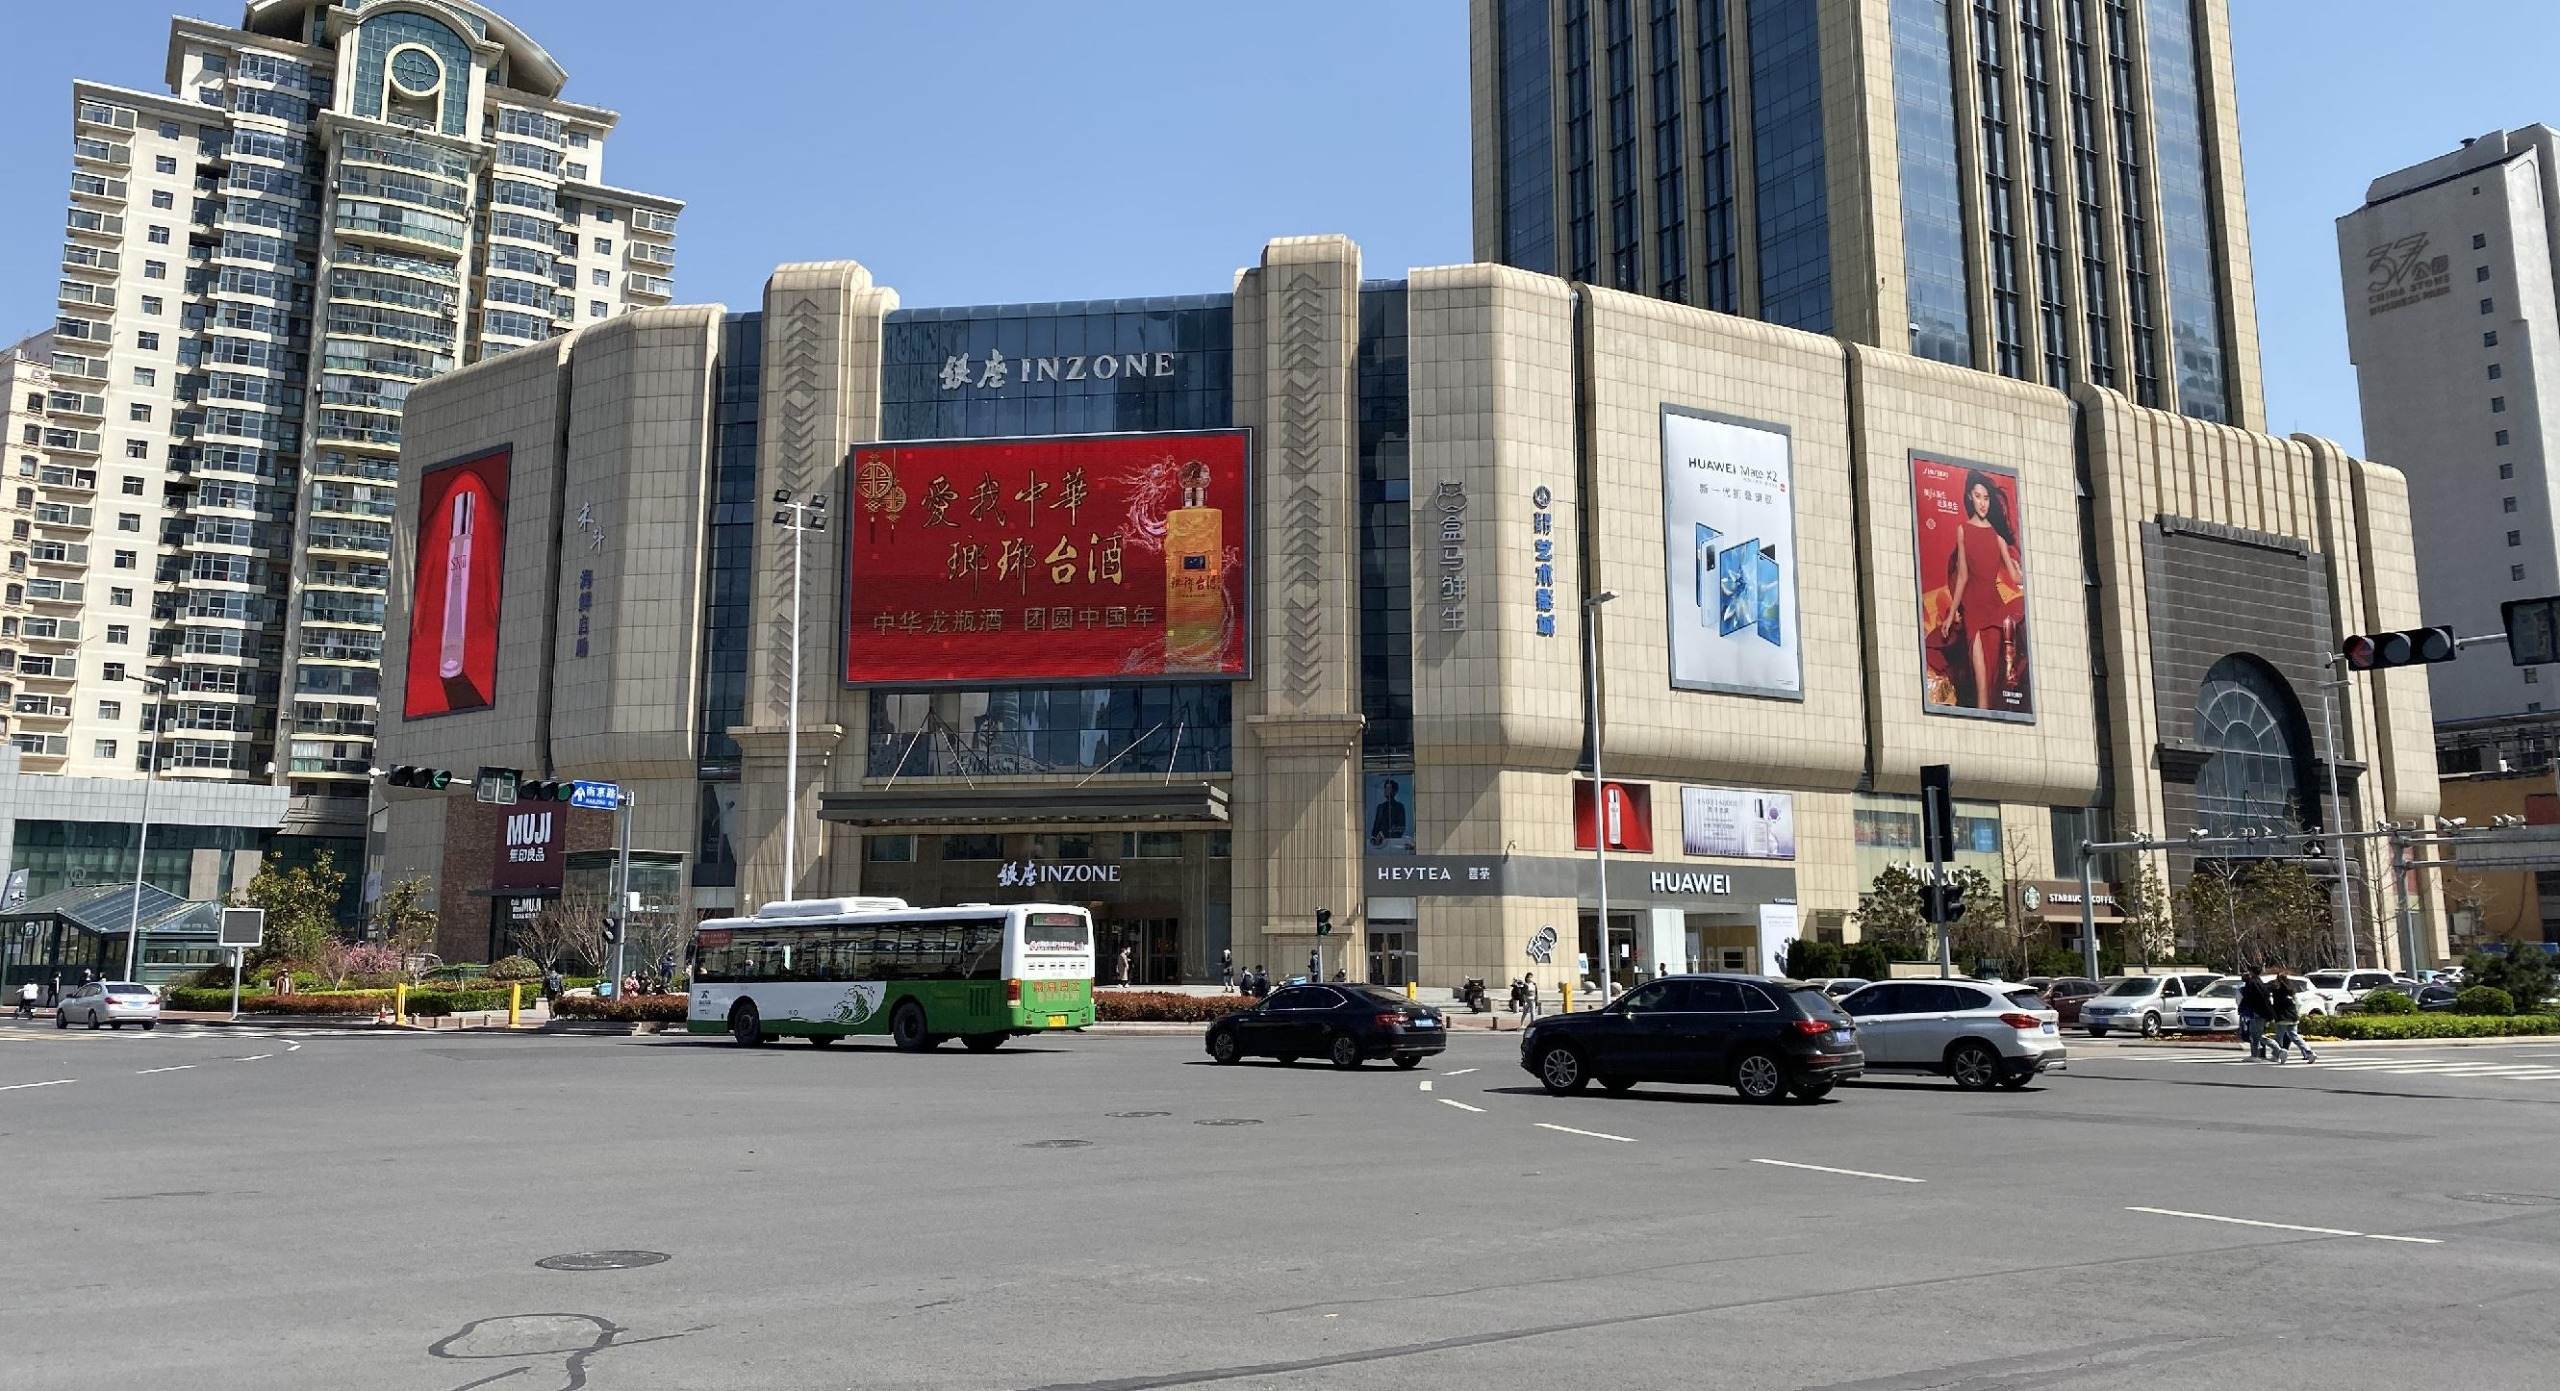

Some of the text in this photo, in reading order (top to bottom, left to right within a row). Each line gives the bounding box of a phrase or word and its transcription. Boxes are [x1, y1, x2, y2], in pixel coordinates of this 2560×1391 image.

[1020, 352, 1176, 384] INZONE
[1688, 457, 1737, 475] HUAWEI
[1440, 515, 1467, 632] 盒马鲜生
[873, 604, 1155, 637] 中华龙瓶酒 团圆中国年
[586, 786, 617, 799] 南京路
[506, 812, 552, 846] MUJI
[509, 847, 545, 863] 無印良品
[1040, 864, 1121, 882] INZONE
[1377, 867, 1490, 881] HEYTEA 喜茶
[1650, 871, 1732, 895] HUAWEI
[522, 897, 542, 913] MUJI
